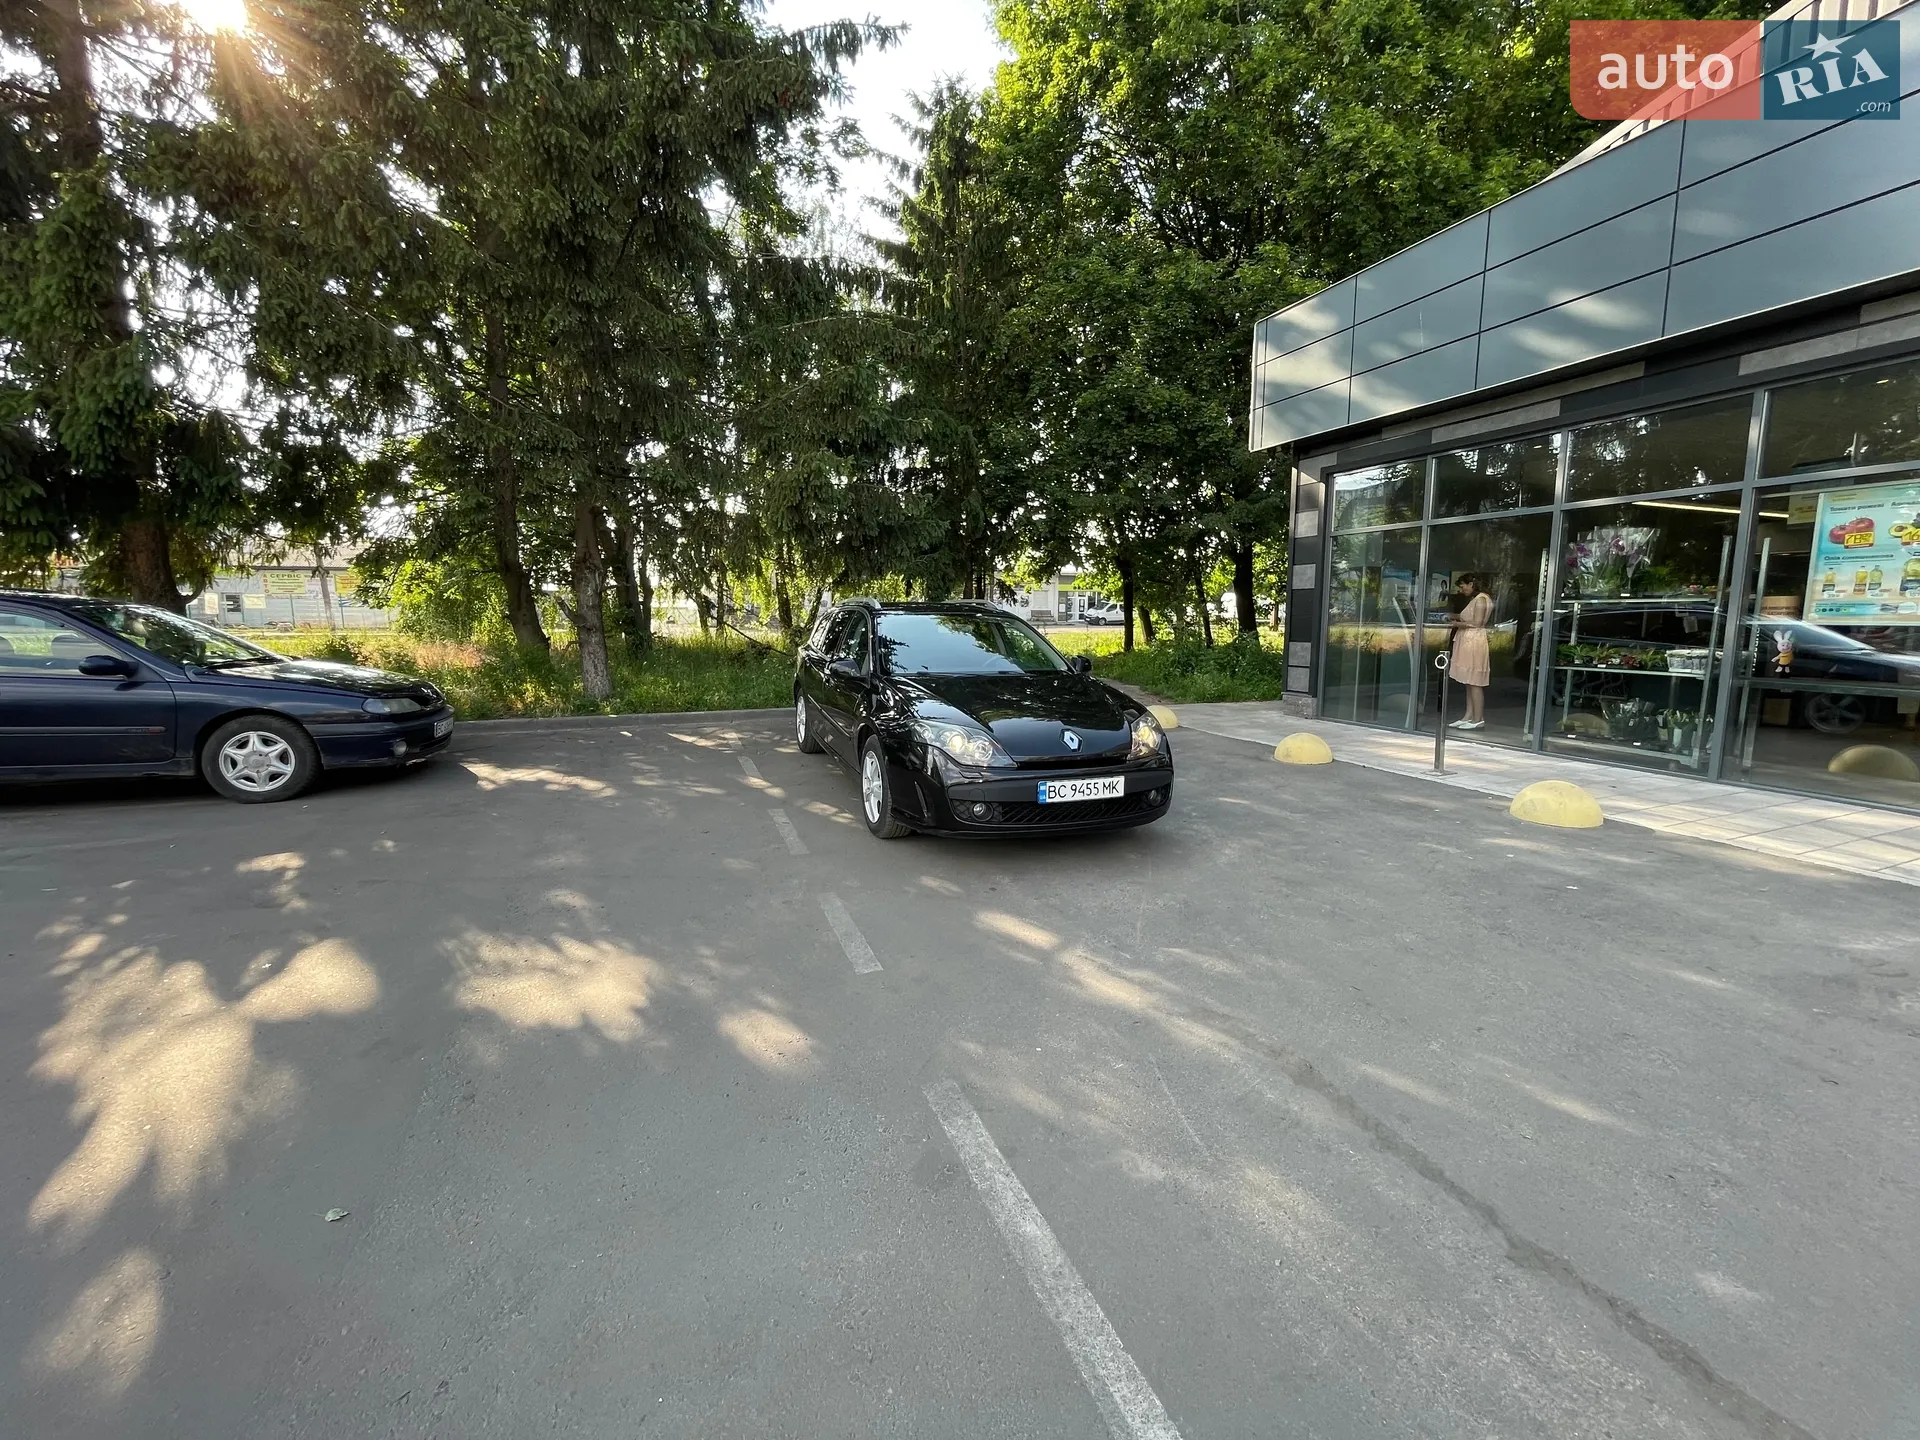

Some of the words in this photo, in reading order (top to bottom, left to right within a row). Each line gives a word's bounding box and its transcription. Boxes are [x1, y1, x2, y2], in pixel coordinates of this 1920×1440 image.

[1048, 785, 1067, 799] BC
[1070, 782, 1100, 798] 9455
[1103, 780, 1120, 794] MK
